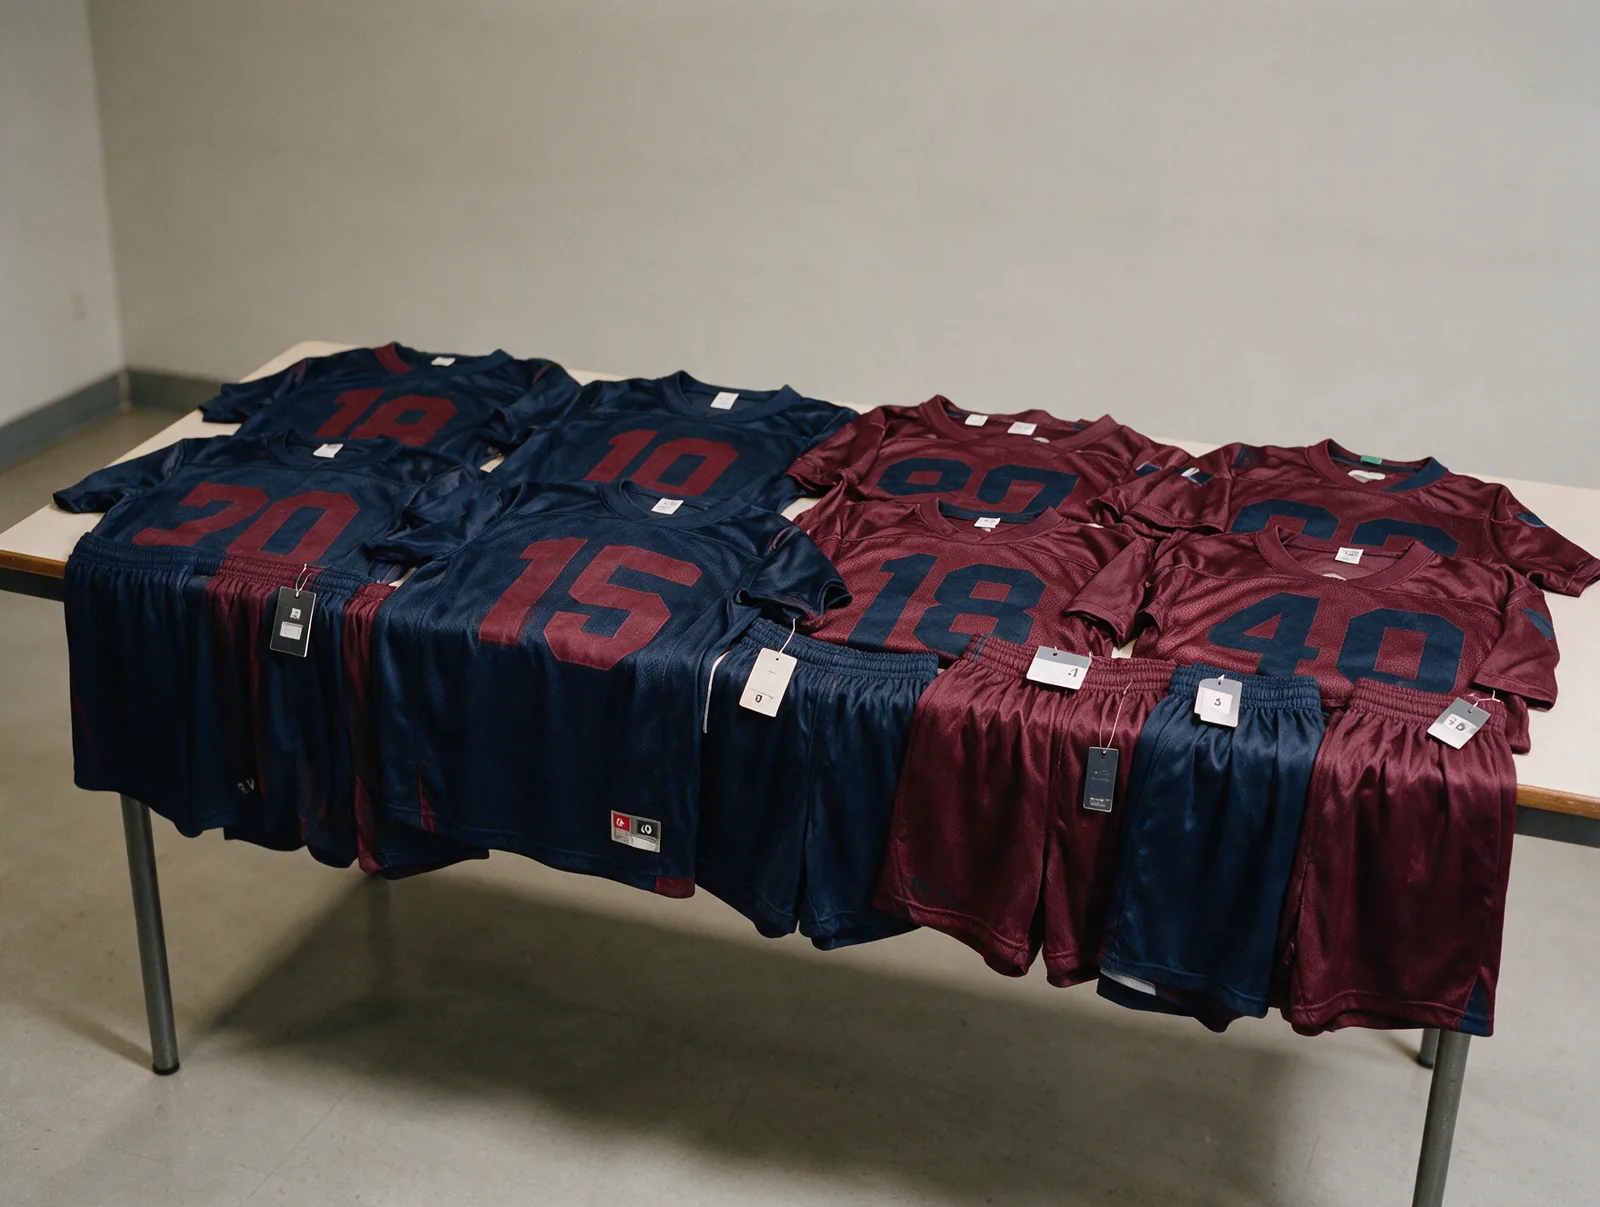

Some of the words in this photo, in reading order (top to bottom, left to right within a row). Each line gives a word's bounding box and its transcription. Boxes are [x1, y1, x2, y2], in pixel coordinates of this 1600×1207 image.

[583, 428, 739, 496] 10
[132, 482, 360, 565] 20
[478, 536, 703, 671] 15
[847, 552, 1047, 656] 18
[1207, 591, 1465, 694] 40
